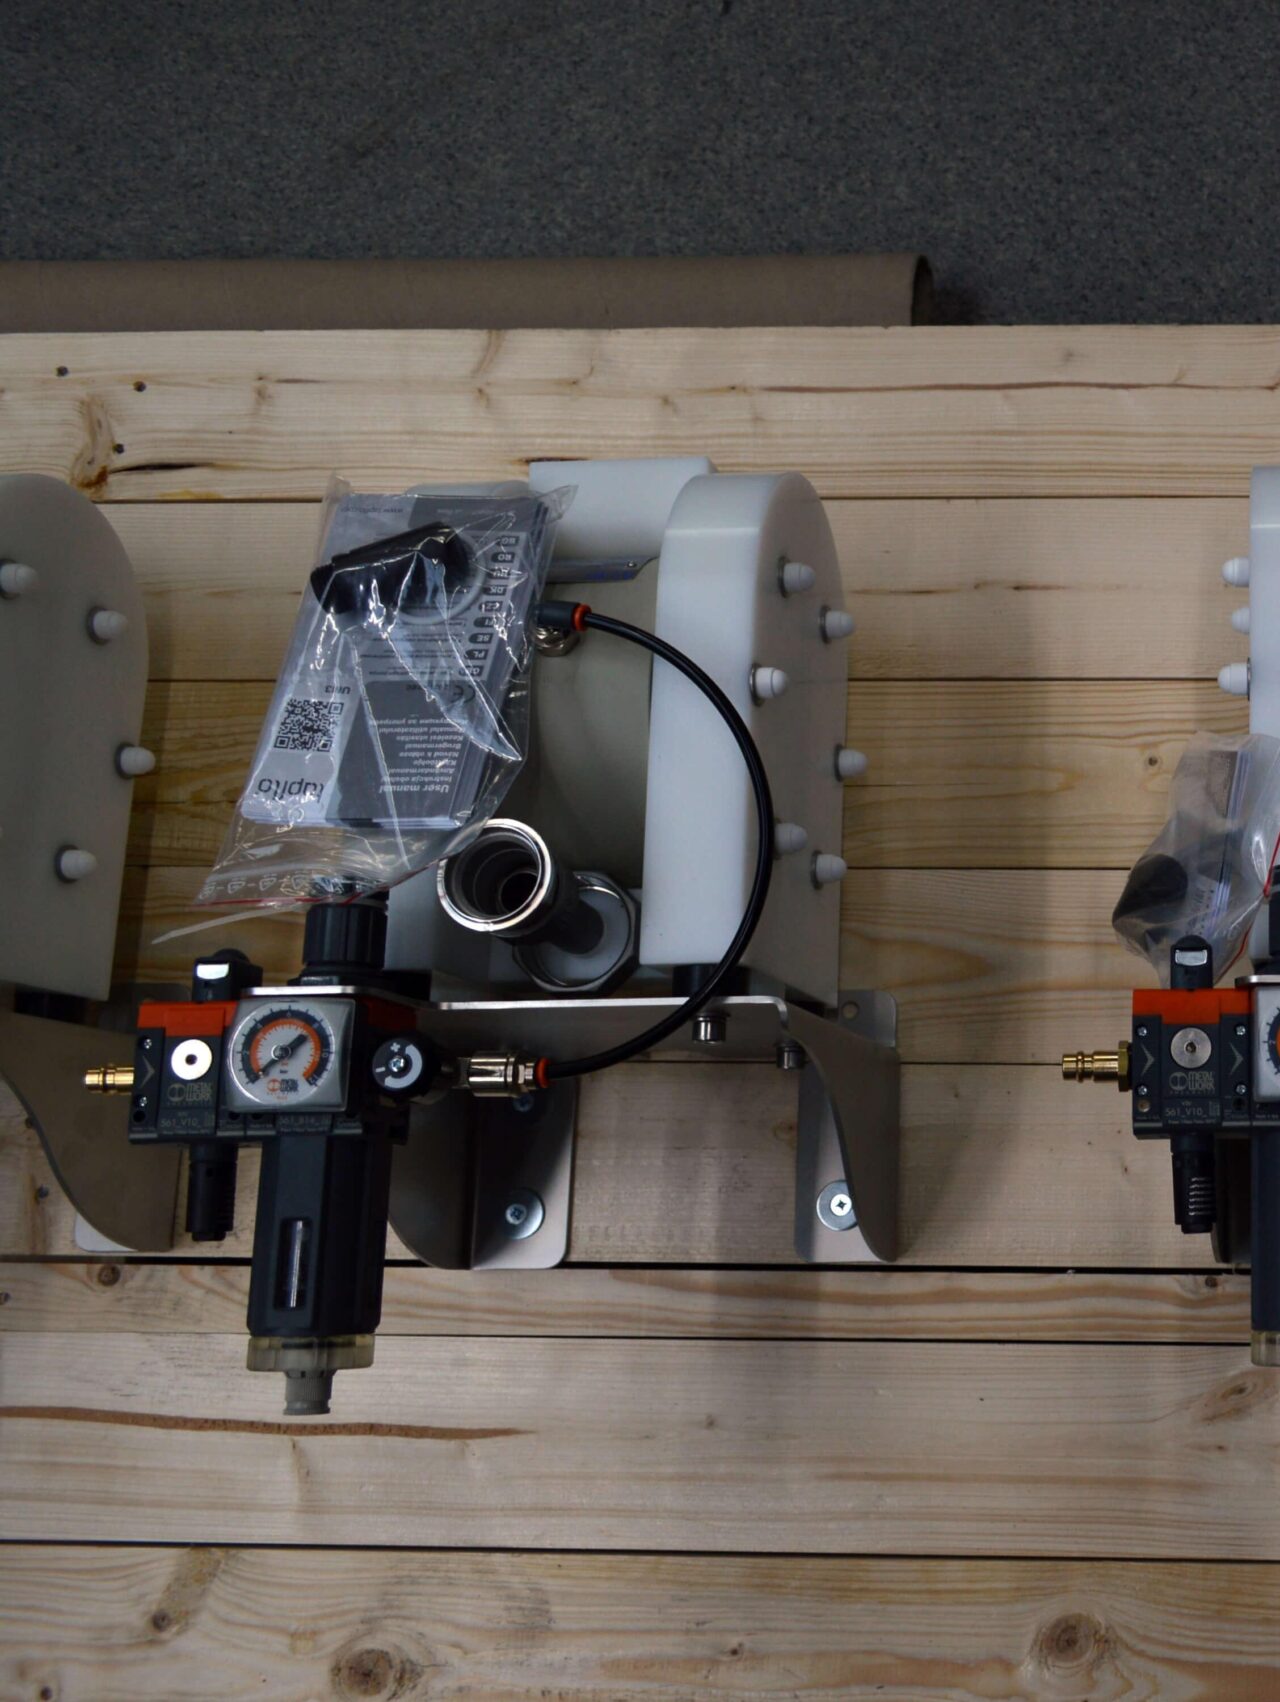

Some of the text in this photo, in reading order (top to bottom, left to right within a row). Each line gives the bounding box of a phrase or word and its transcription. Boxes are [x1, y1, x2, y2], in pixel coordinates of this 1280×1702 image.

[497, 553, 512, 561] RO
[488, 586, 505, 594] DK
[476, 634, 491, 643] SE
[472, 650, 486, 659] PL
[422, 784, 450, 794] User
